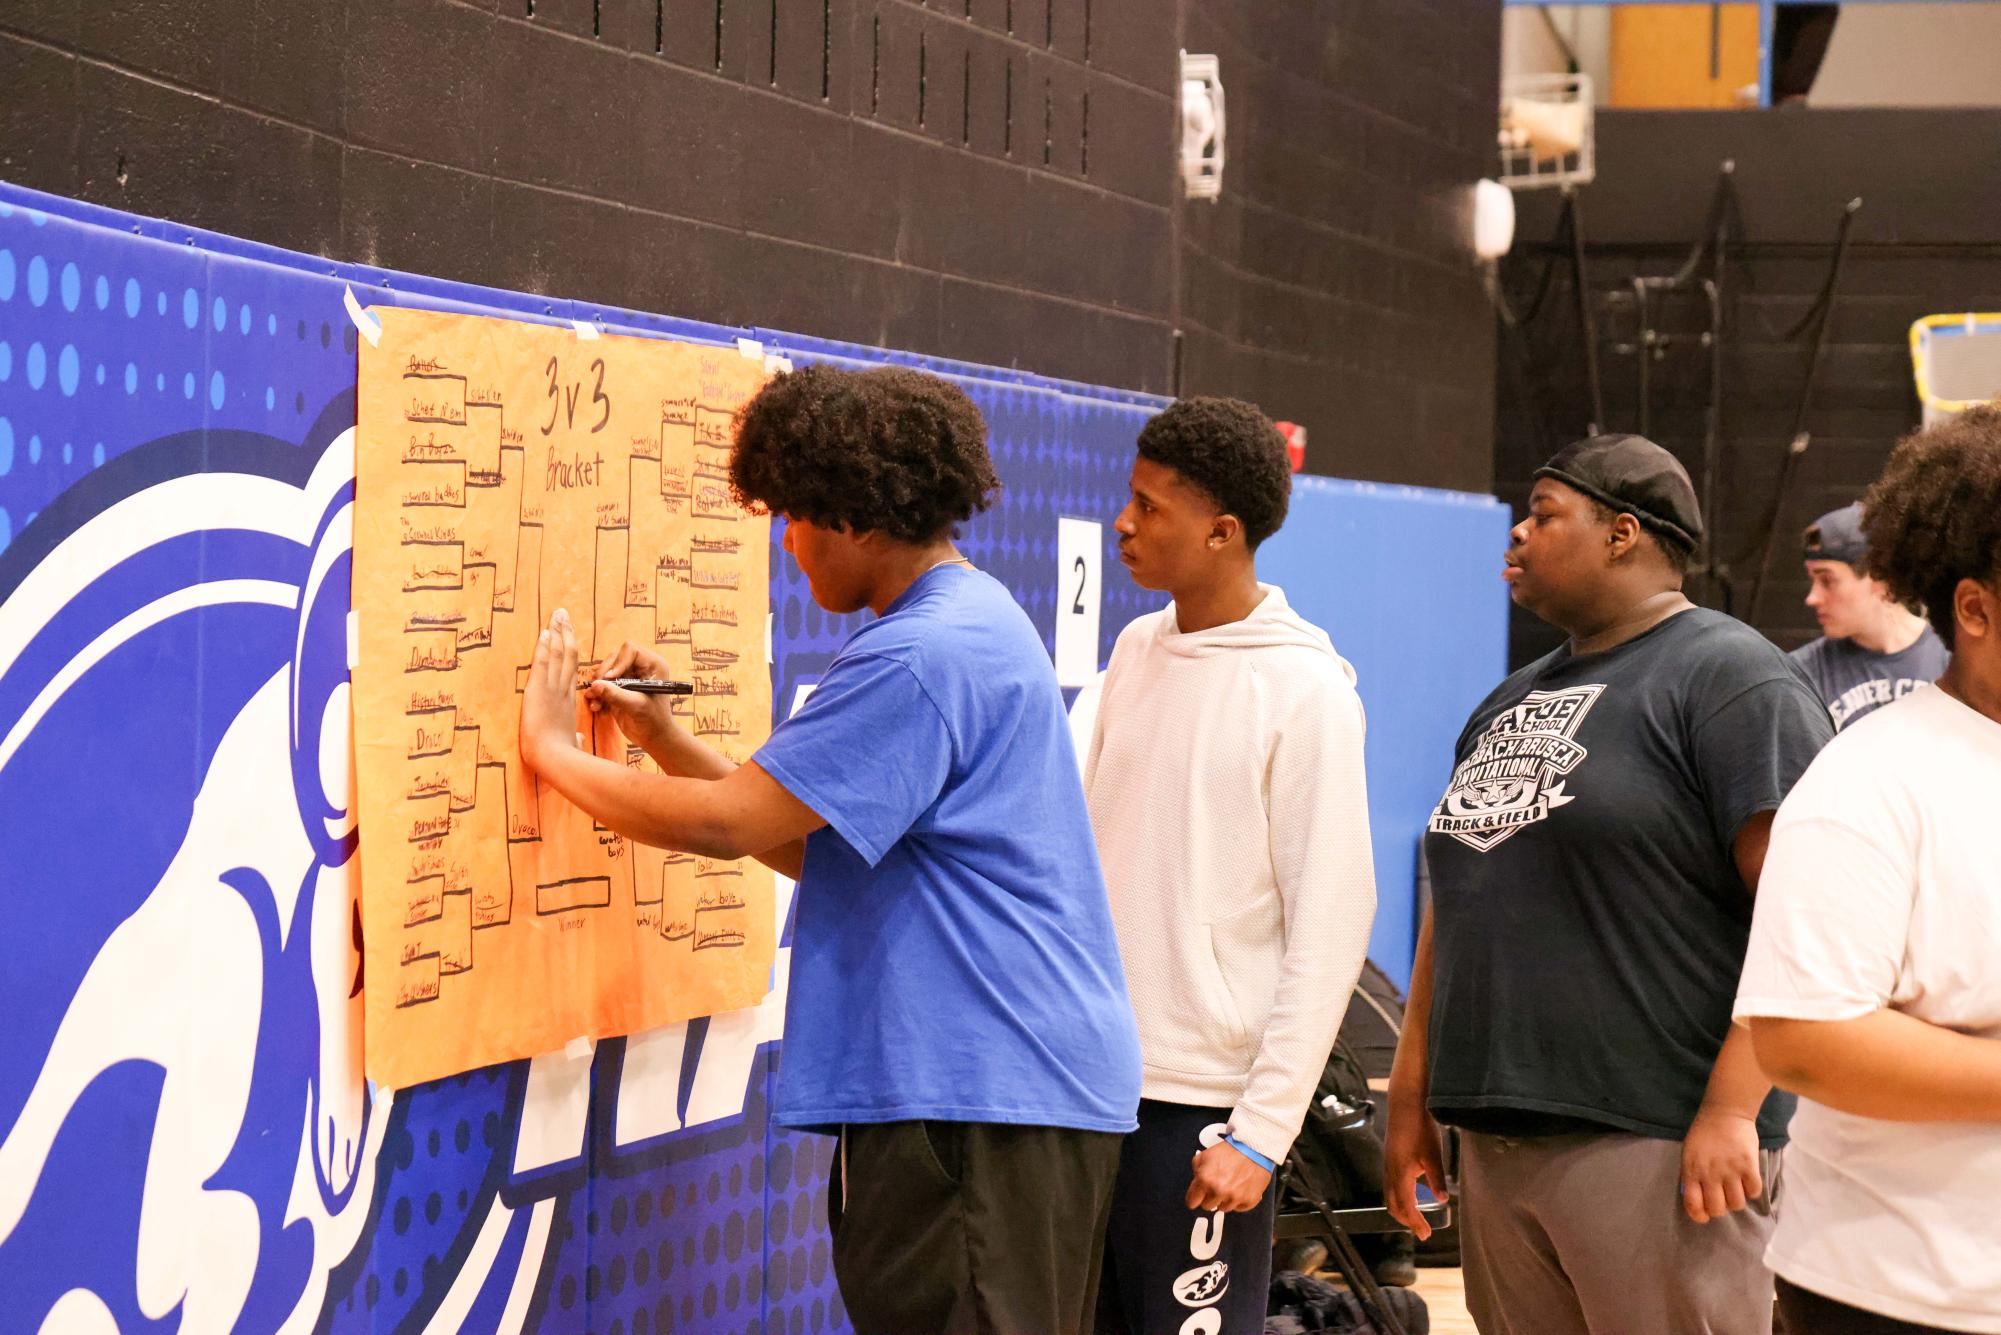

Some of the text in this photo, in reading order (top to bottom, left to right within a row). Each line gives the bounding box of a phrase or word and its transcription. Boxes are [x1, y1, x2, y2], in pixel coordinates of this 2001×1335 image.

[1072, 556, 1086, 615] 2
[1454, 757, 1537, 790] INVITATIONAL
[1436, 805, 1541, 832] TRACK & FIELD
